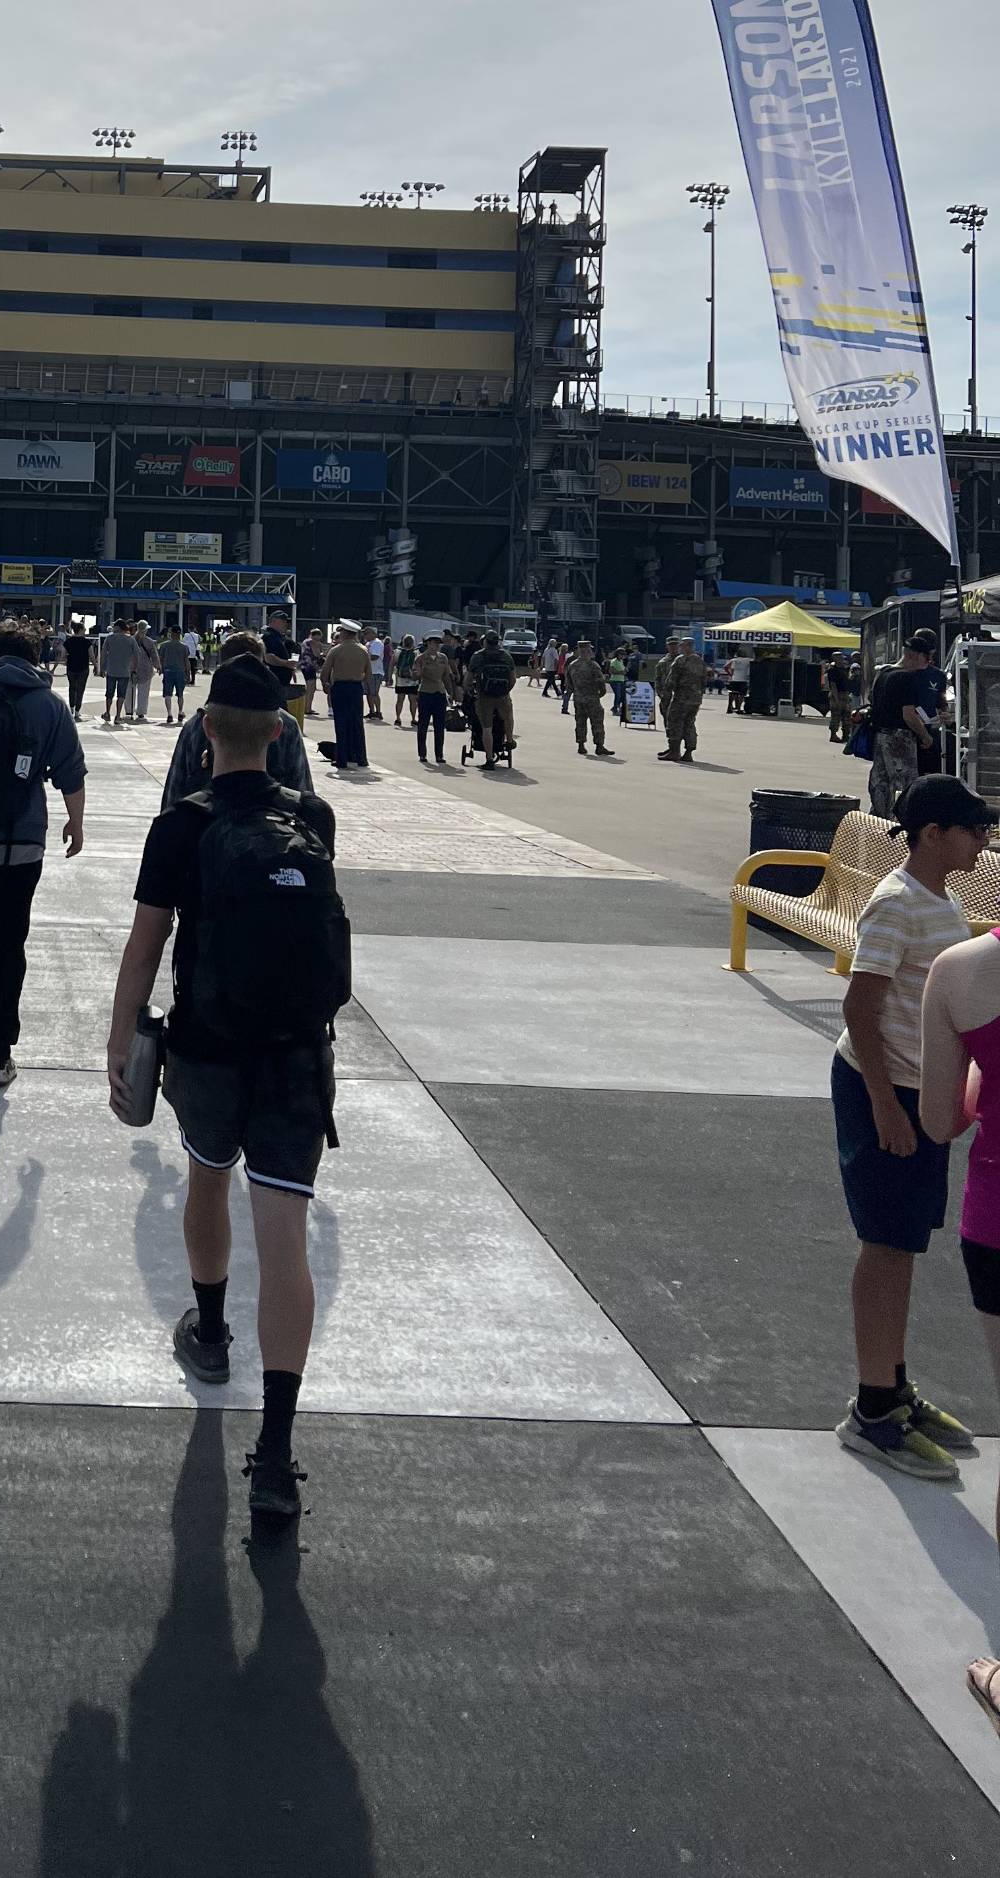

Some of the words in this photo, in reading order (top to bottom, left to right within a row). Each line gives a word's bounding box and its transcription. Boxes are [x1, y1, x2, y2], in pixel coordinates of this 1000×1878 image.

[839, 47, 862, 89] 2021
[806, 107, 852, 187] KYLE
[817, 385, 901, 407] KANSAS
[816, 400, 901, 415] SPEEDWAY
[855, 419, 879, 431] CUP
[887, 414, 933, 428] SERIES
[16, 453, 61, 469] DAWN
[134, 459, 182, 471] START
[312, 465, 351, 484] CABO
[627, 474, 661, 489] IBEW
[664, 476, 688, 490] 124
[736, 486, 824, 503] AdventHealth
